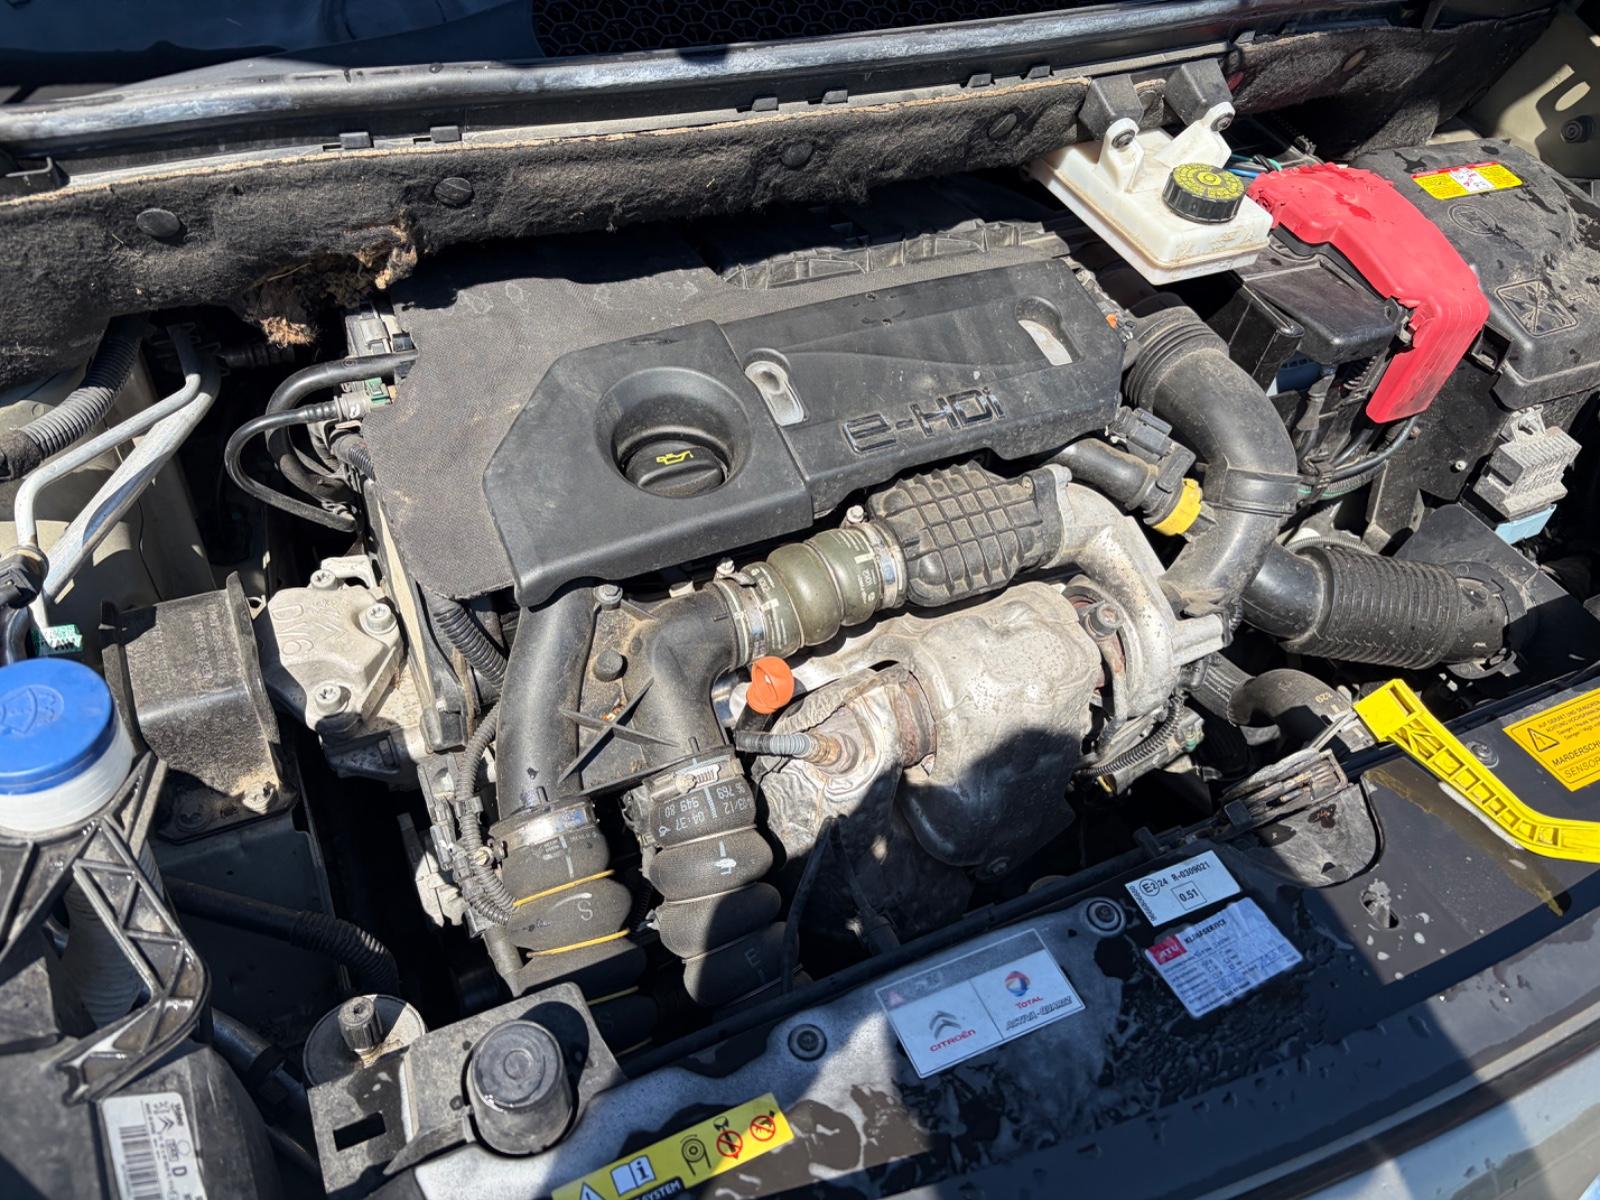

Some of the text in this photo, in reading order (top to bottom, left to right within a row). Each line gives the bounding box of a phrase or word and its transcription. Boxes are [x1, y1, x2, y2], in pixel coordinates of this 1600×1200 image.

[1178, 888, 1199, 902] 0.51
[1013, 996, 1043, 1009] TOTAL
[929, 1028, 976, 1052] CITROËN
[172, 1166, 187, 1177] D
